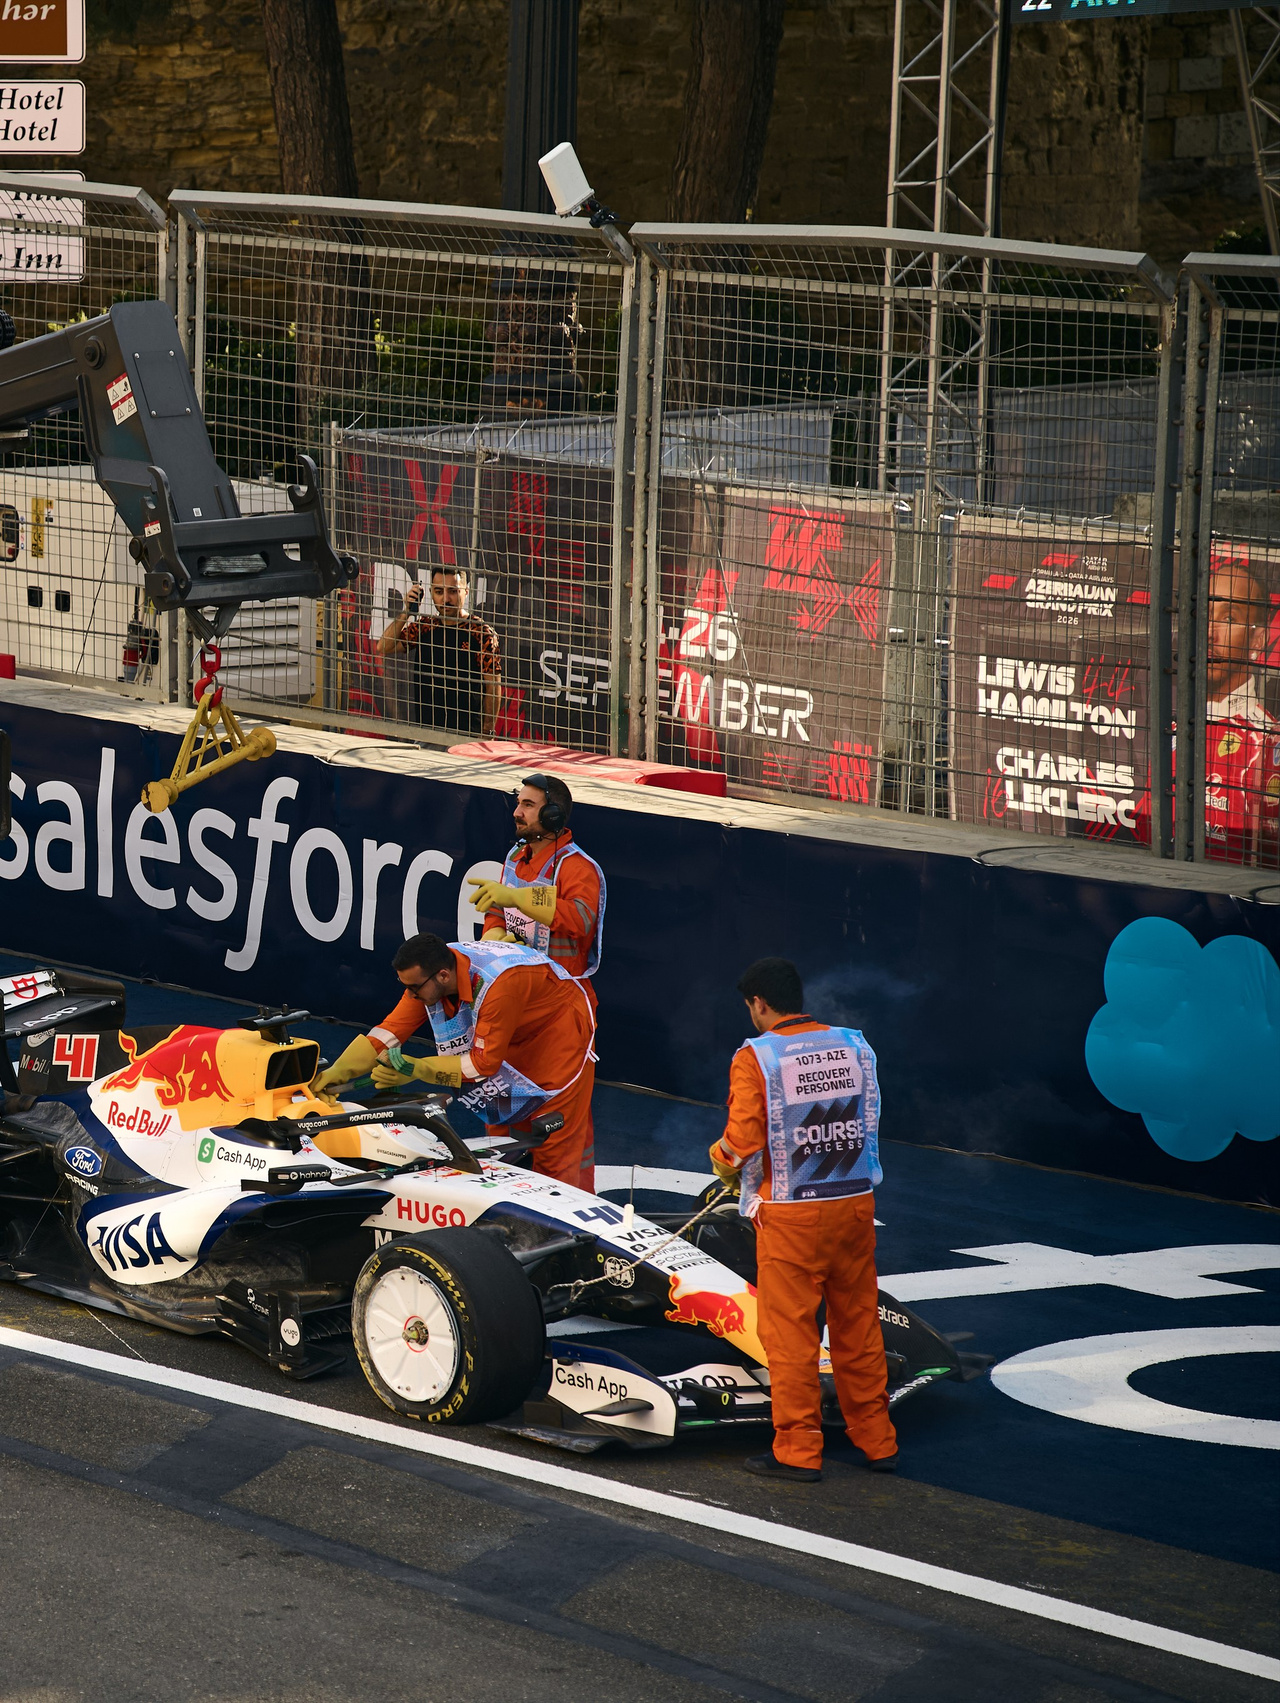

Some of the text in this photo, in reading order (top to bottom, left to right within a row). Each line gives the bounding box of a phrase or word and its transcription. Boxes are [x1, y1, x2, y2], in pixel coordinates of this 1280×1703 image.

[10, 247, 63, 269] Inn
[1025, 578, 1118, 602] AZERBAIJAN
[1026, 594, 1114, 618] GRAND PRIX
[1057, 615, 1079, 625] 2026
[978, 655, 1076, 696] LEWIS
[978, 688, 1136, 740] HAMILTON
[996, 746, 1135, 795] CHARLES
[1004, 779, 1136, 829] LECLERC
[435, 1034, 469, 1053] 6-AZE
[20, 1054, 45, 1074] Mobil
[52, 1034, 100, 1081] 41
[795, 1050, 848, 1067] 1073-AZE
[796, 1078, 856, 1097] PERSONNEL
[798, 1067, 851, 1084] RECOVERY
[107, 1101, 173, 1138] Red Bull
[793, 1119, 865, 1146] COURSE
[803, 1139, 863, 1155] ACCESS
[72, 1149, 96, 1173] Ford
[217, 1147, 267, 1172] Cash App
[65, 1172, 99, 1196] RACING
[300, 1169, 332, 1179] hahnair
[397, 1198, 467, 1228] HUGO
[573, 1205, 624, 1226] 41
[91, 1211, 190, 1271] VISA
[612, 1227, 671, 1242] VISA
[878, 1306, 910, 1329] atrace
[555, 1367, 628, 1401] Cash App
[427, 1374, 471, 1424] ZERO
